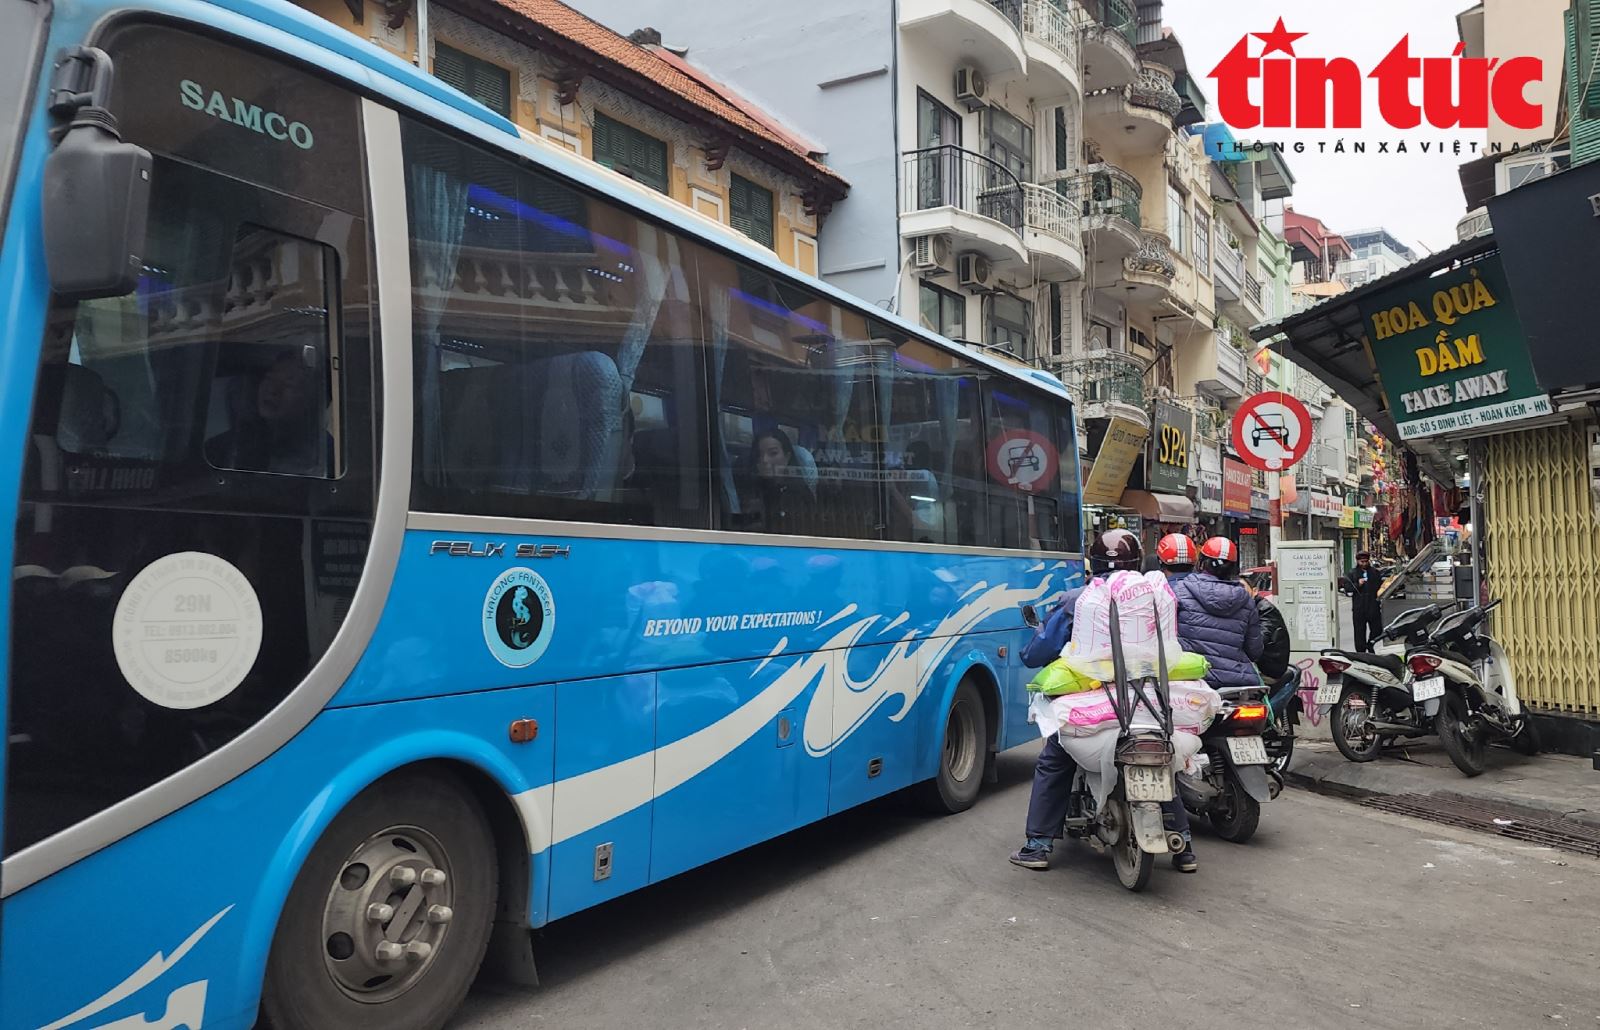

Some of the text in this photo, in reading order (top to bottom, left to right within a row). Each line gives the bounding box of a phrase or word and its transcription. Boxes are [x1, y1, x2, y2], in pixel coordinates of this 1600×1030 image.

[180, 79, 314, 150] SAMCO
[1371, 267, 1496, 340] HOA QUẢ
[1416, 330, 1485, 376] DẦM
[1400, 369, 1509, 413] TAKE AWAY
[1432, 422, 1437, 431] 5
[1458, 412, 1473, 427] LIỆT
[1480, 409, 1502, 422] HOÀN
[1535, 399, 1548, 412] HN
[1159, 423, 1187, 469] SPA
[430, 540, 507, 562] FELIX
[173, 594, 212, 613] 29N
[486, 572, 552, 620] HALONG FANTASEA
[643, 617, 702, 637] BEYOND
[705, 614, 739, 633] YOUR
[740, 610, 817, 630] EXPECTATIONS
